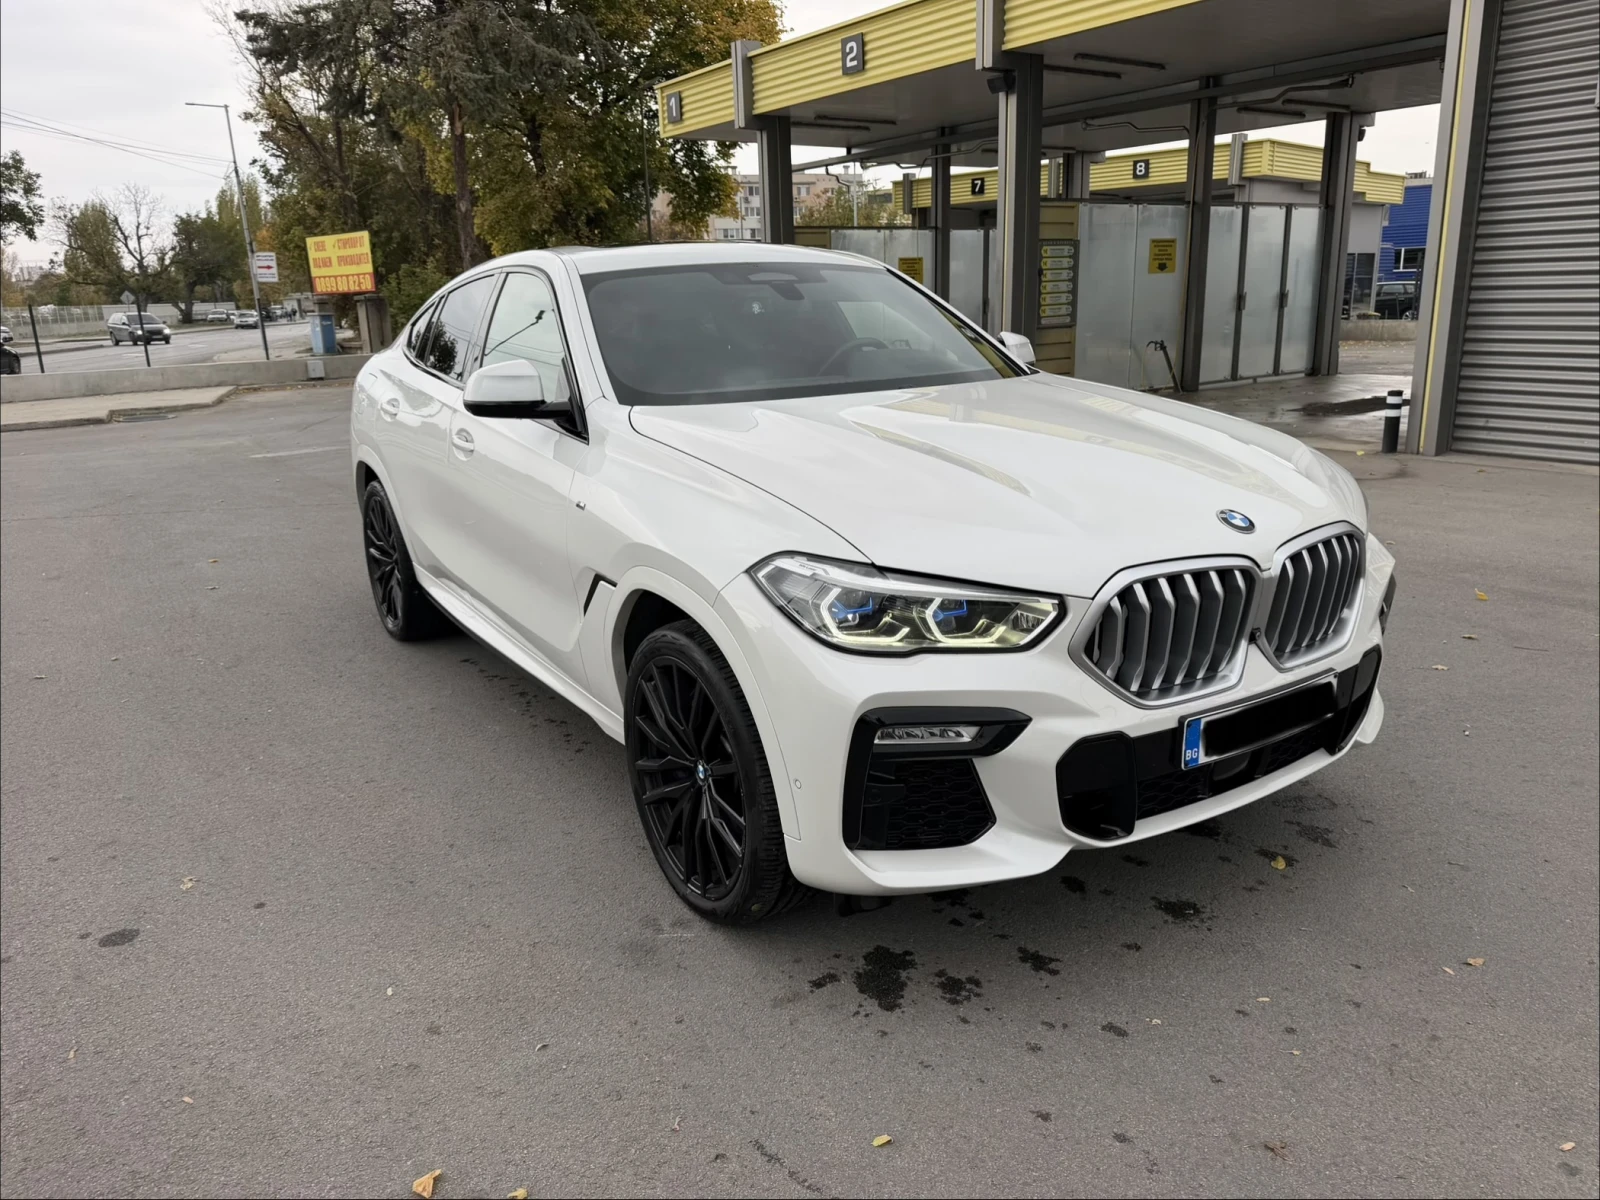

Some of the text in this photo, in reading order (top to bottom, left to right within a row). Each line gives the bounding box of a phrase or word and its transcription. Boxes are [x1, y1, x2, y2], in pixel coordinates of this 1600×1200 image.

[846, 41, 858, 67] 2
[669, 97, 676, 117] 1
[1136, 162, 1145, 175] 8
[974, 180, 981, 192] 7
[1186, 748, 1198, 760] BG
